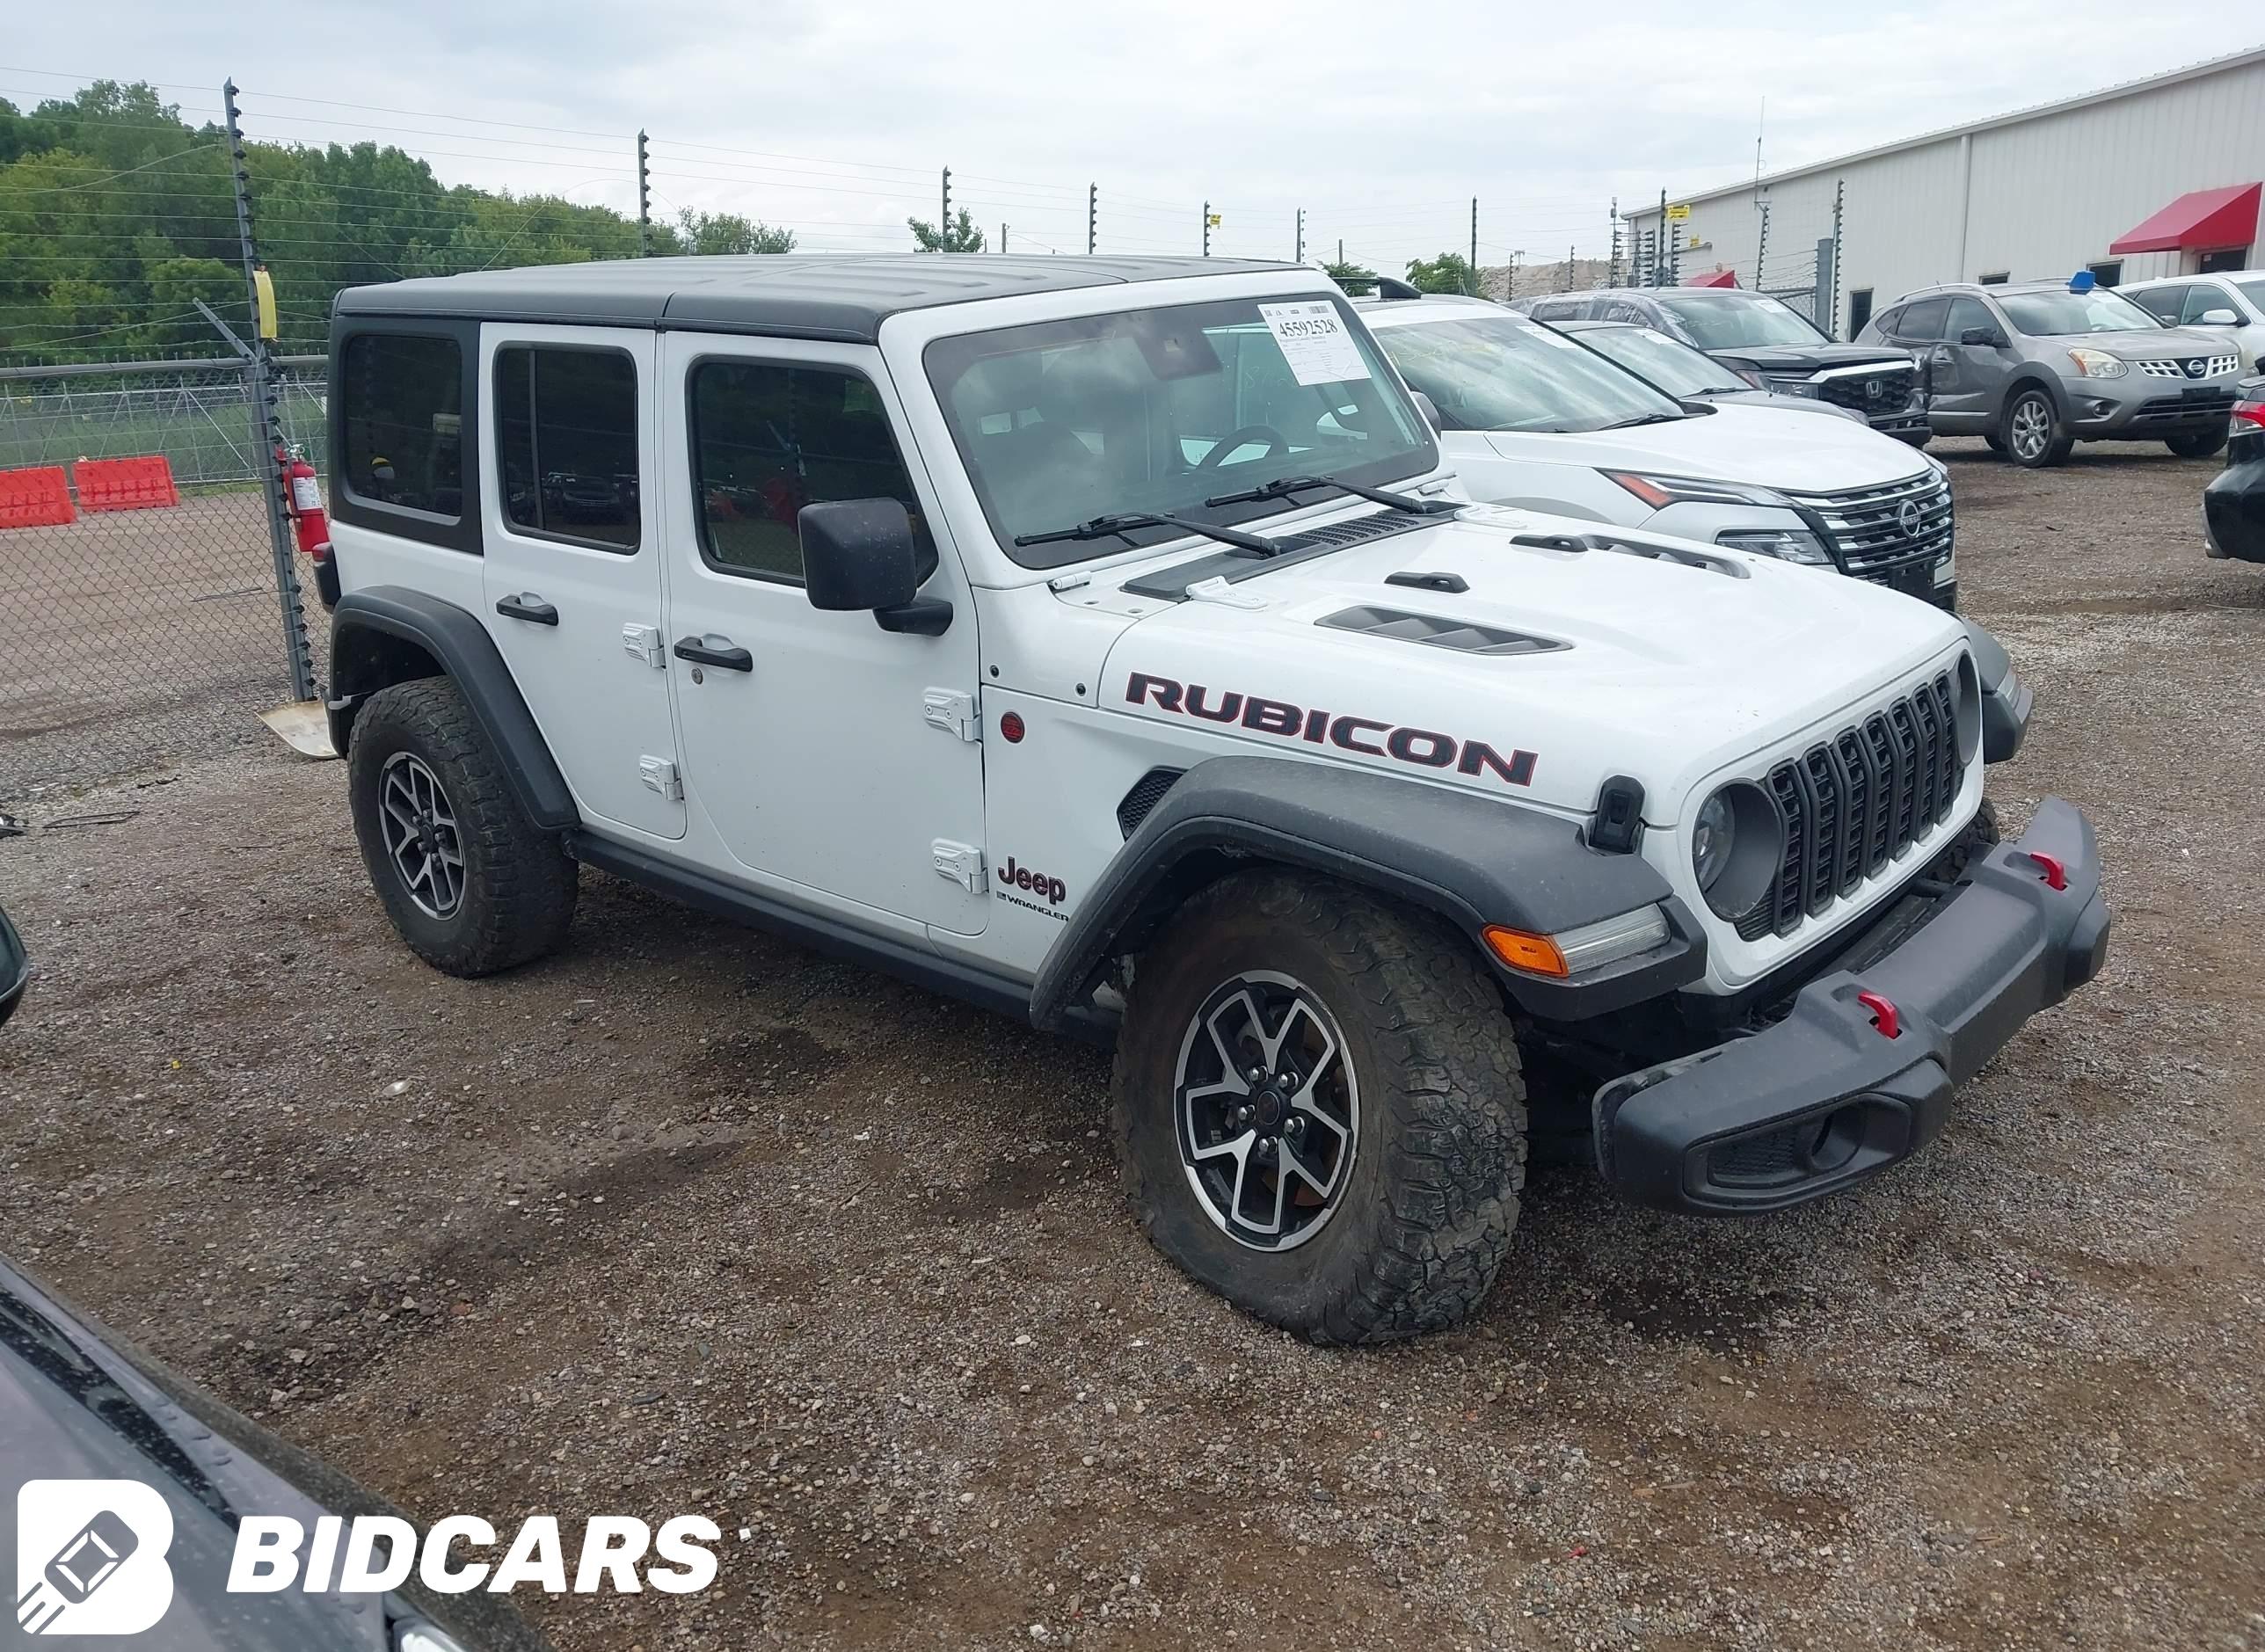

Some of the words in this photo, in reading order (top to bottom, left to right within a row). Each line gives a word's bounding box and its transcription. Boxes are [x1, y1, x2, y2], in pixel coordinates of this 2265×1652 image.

[1279, 318, 1338, 337] 45592528
[1125, 671, 1539, 787] RUBICON
[998, 855, 1067, 906] Jeep
[1007, 894, 1069, 922] WRANGLER
